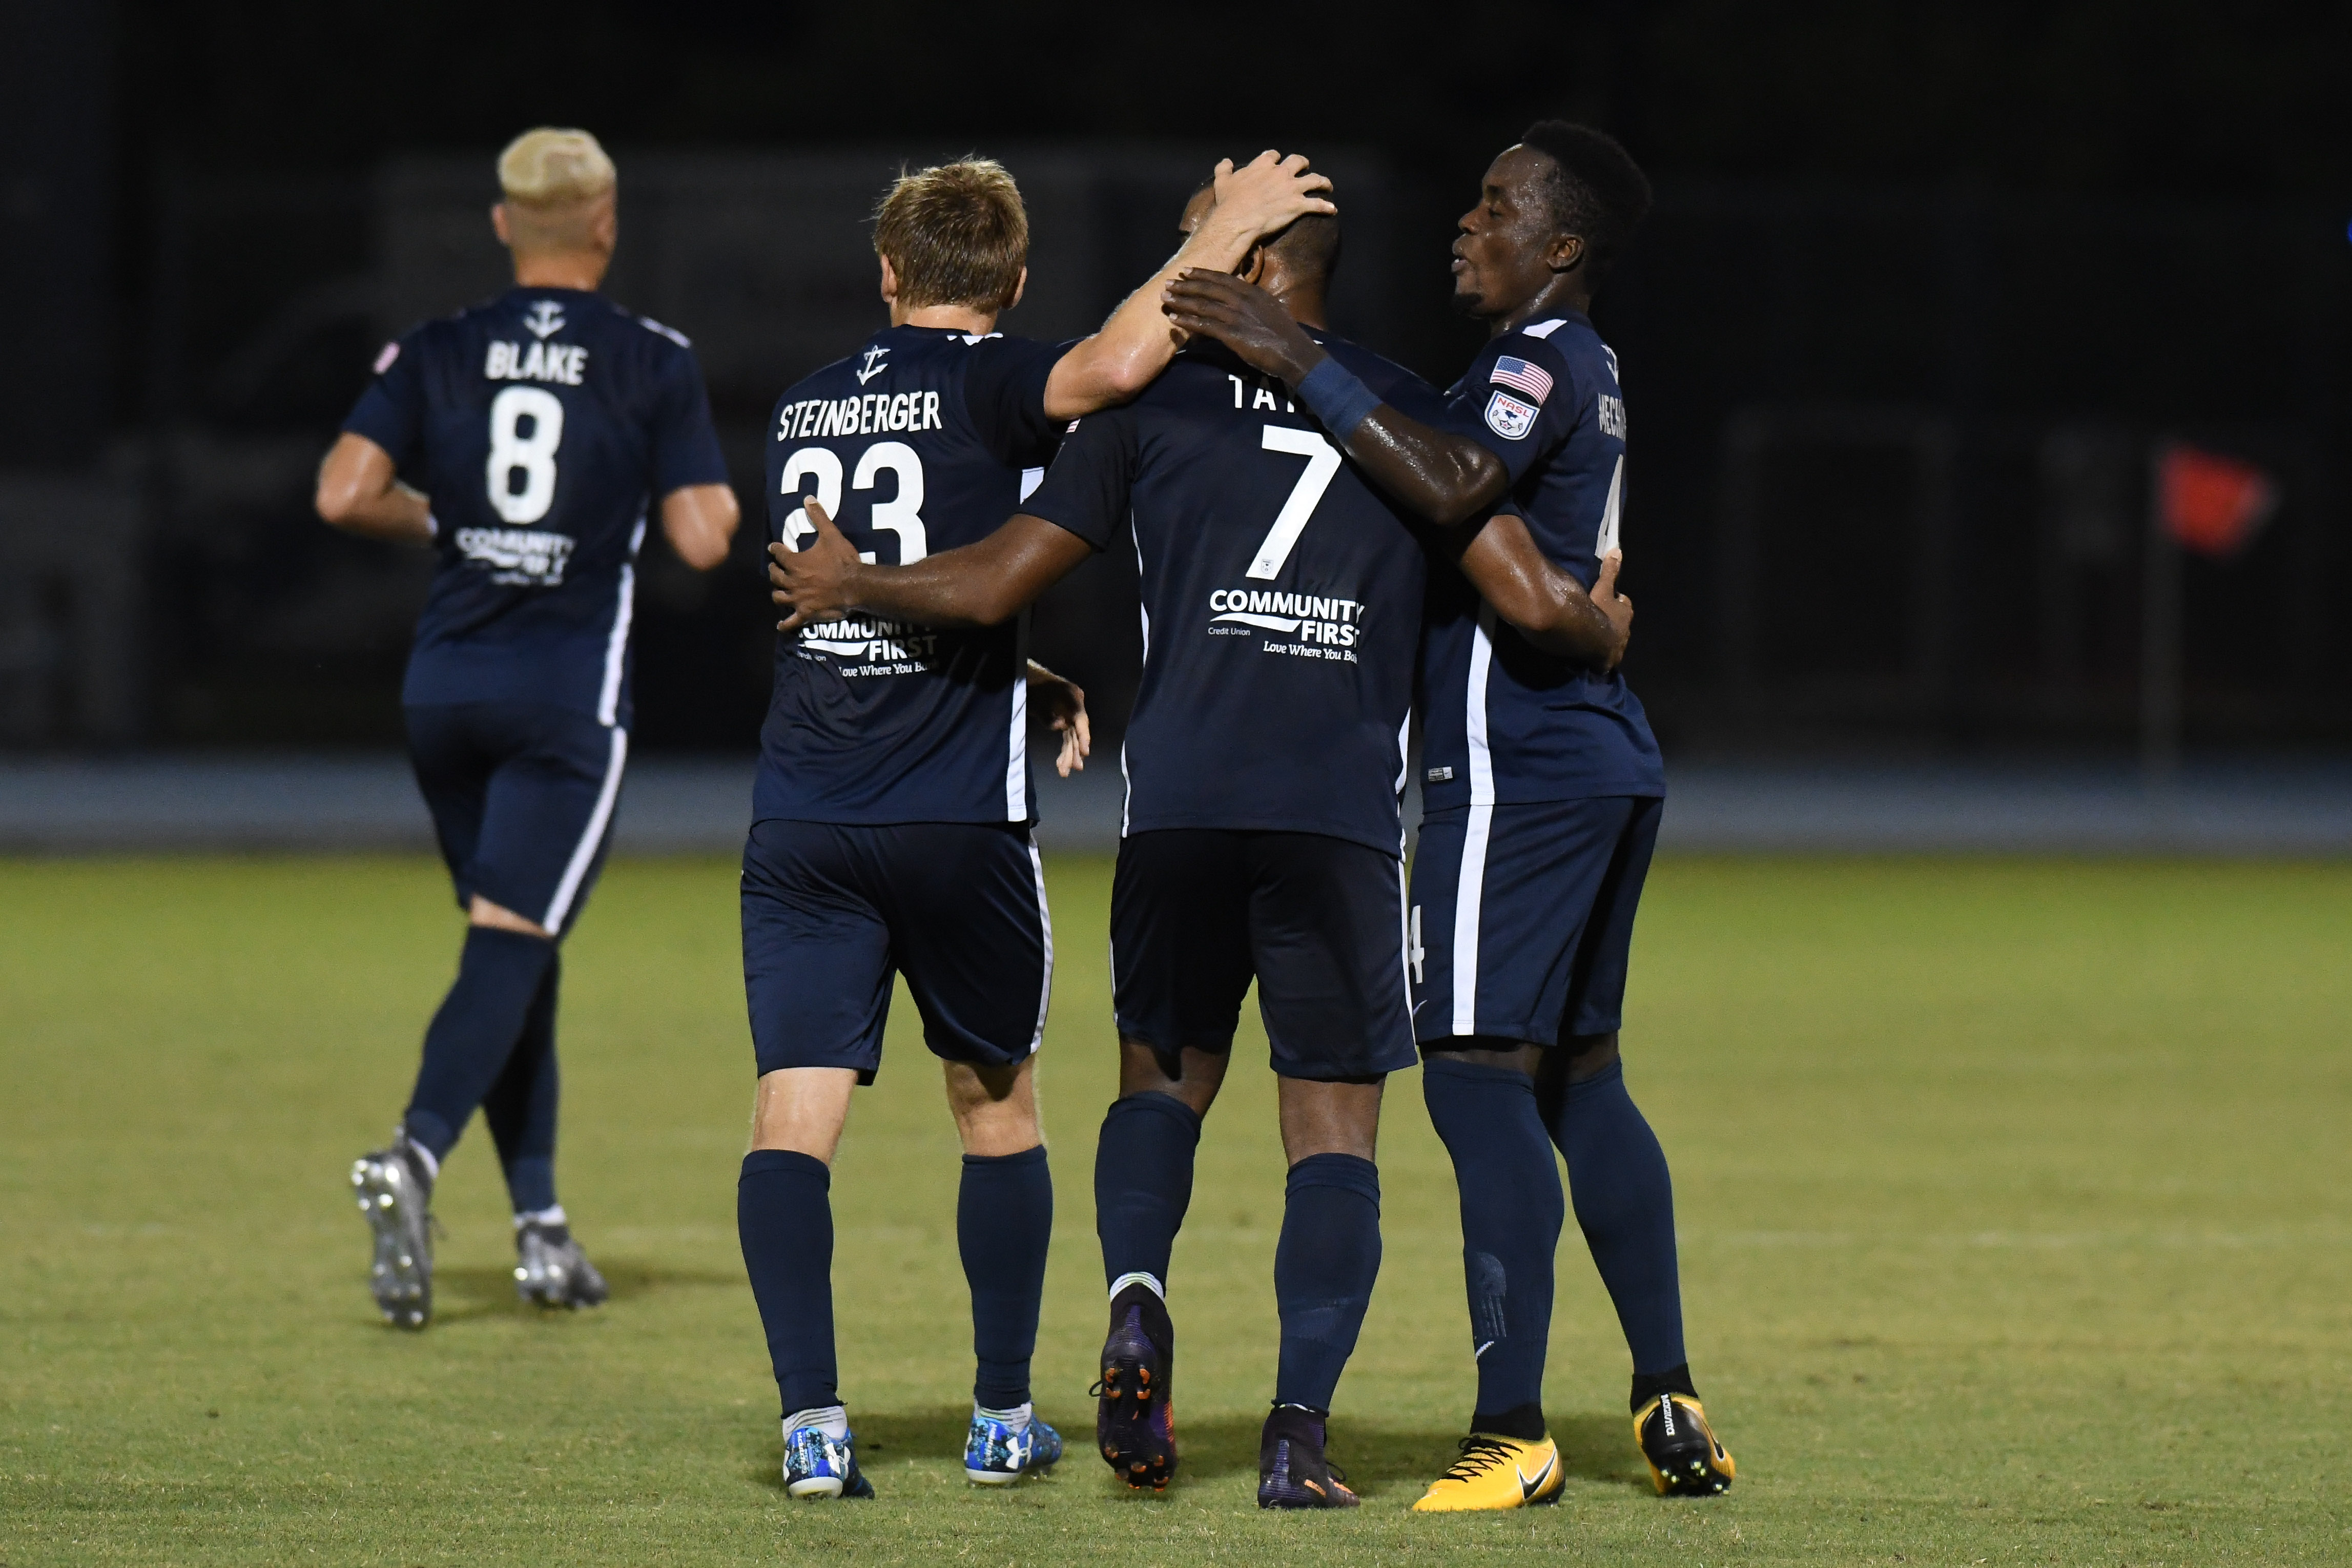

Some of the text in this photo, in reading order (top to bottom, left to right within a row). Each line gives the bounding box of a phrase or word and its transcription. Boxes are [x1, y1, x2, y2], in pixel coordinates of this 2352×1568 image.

[485, 340, 588, 386] BLAKE
[777, 390, 942, 441] STEINBERGER
[1497, 397, 1529, 418] NASL
[486, 386, 564, 525] 8
[781, 441, 927, 566] 23
[1246, 425, 1342, 580] 7
[1210, 590, 1365, 624] COMMUNITY
[798, 617, 931, 639] OMMUNI
[1208, 627, 1250, 636] Credit Union
[869, 635, 937, 662] FIRST
[1263, 641, 1287, 654] Love
[1288, 644, 1322, 658] Where
[1324, 648, 1342, 661] You
[859, 665, 892, 676] Where
[892, 663, 913, 674] You
